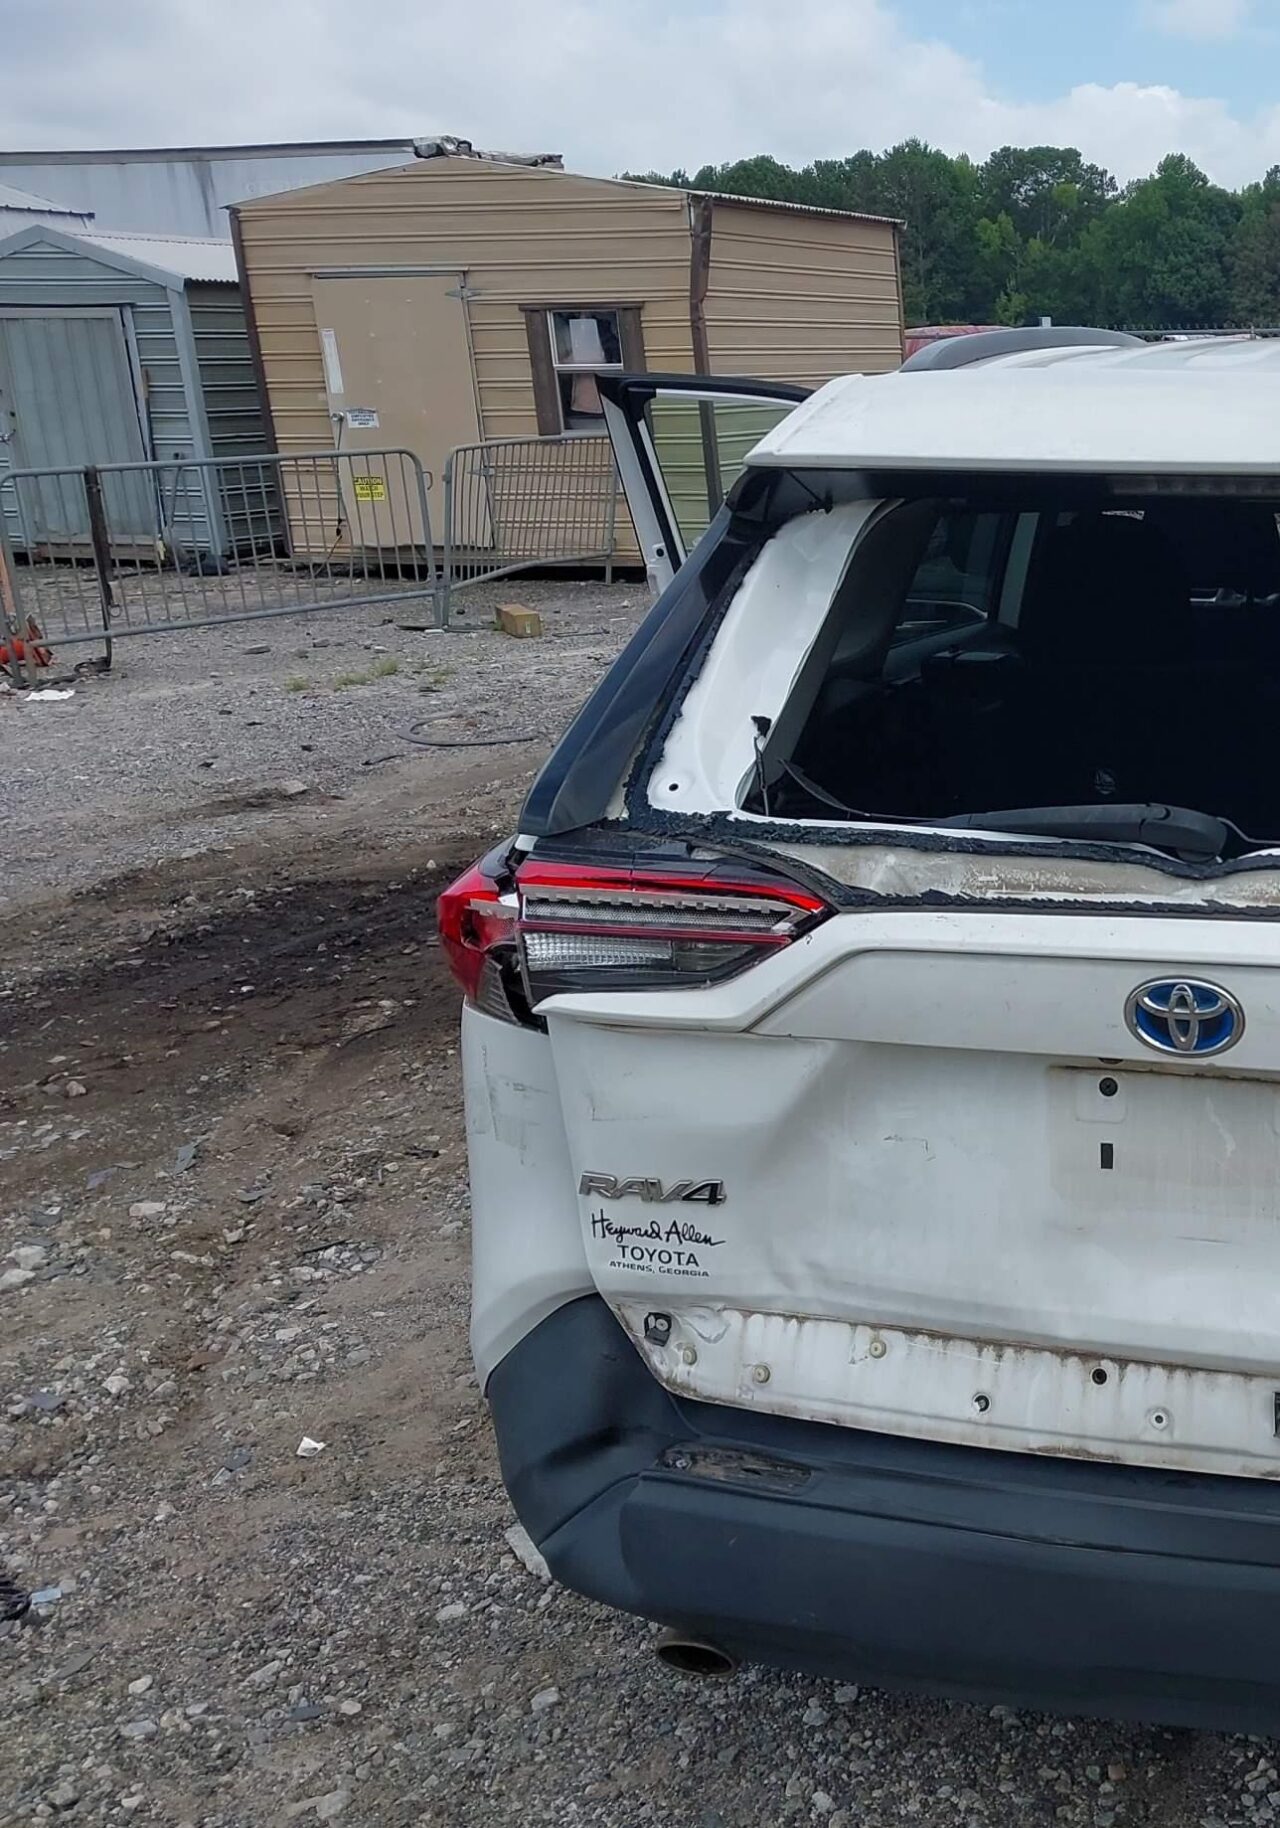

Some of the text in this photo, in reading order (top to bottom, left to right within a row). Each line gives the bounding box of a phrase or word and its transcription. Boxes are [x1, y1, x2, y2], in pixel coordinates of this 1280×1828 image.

[579, 1171, 727, 1206] RAV4
[591, 1208, 727, 1247] Heyward Allen
[609, 1261, 710, 1277] ATHENS, GEORGIA
[617, 1245, 699, 1267] TOYOTA
